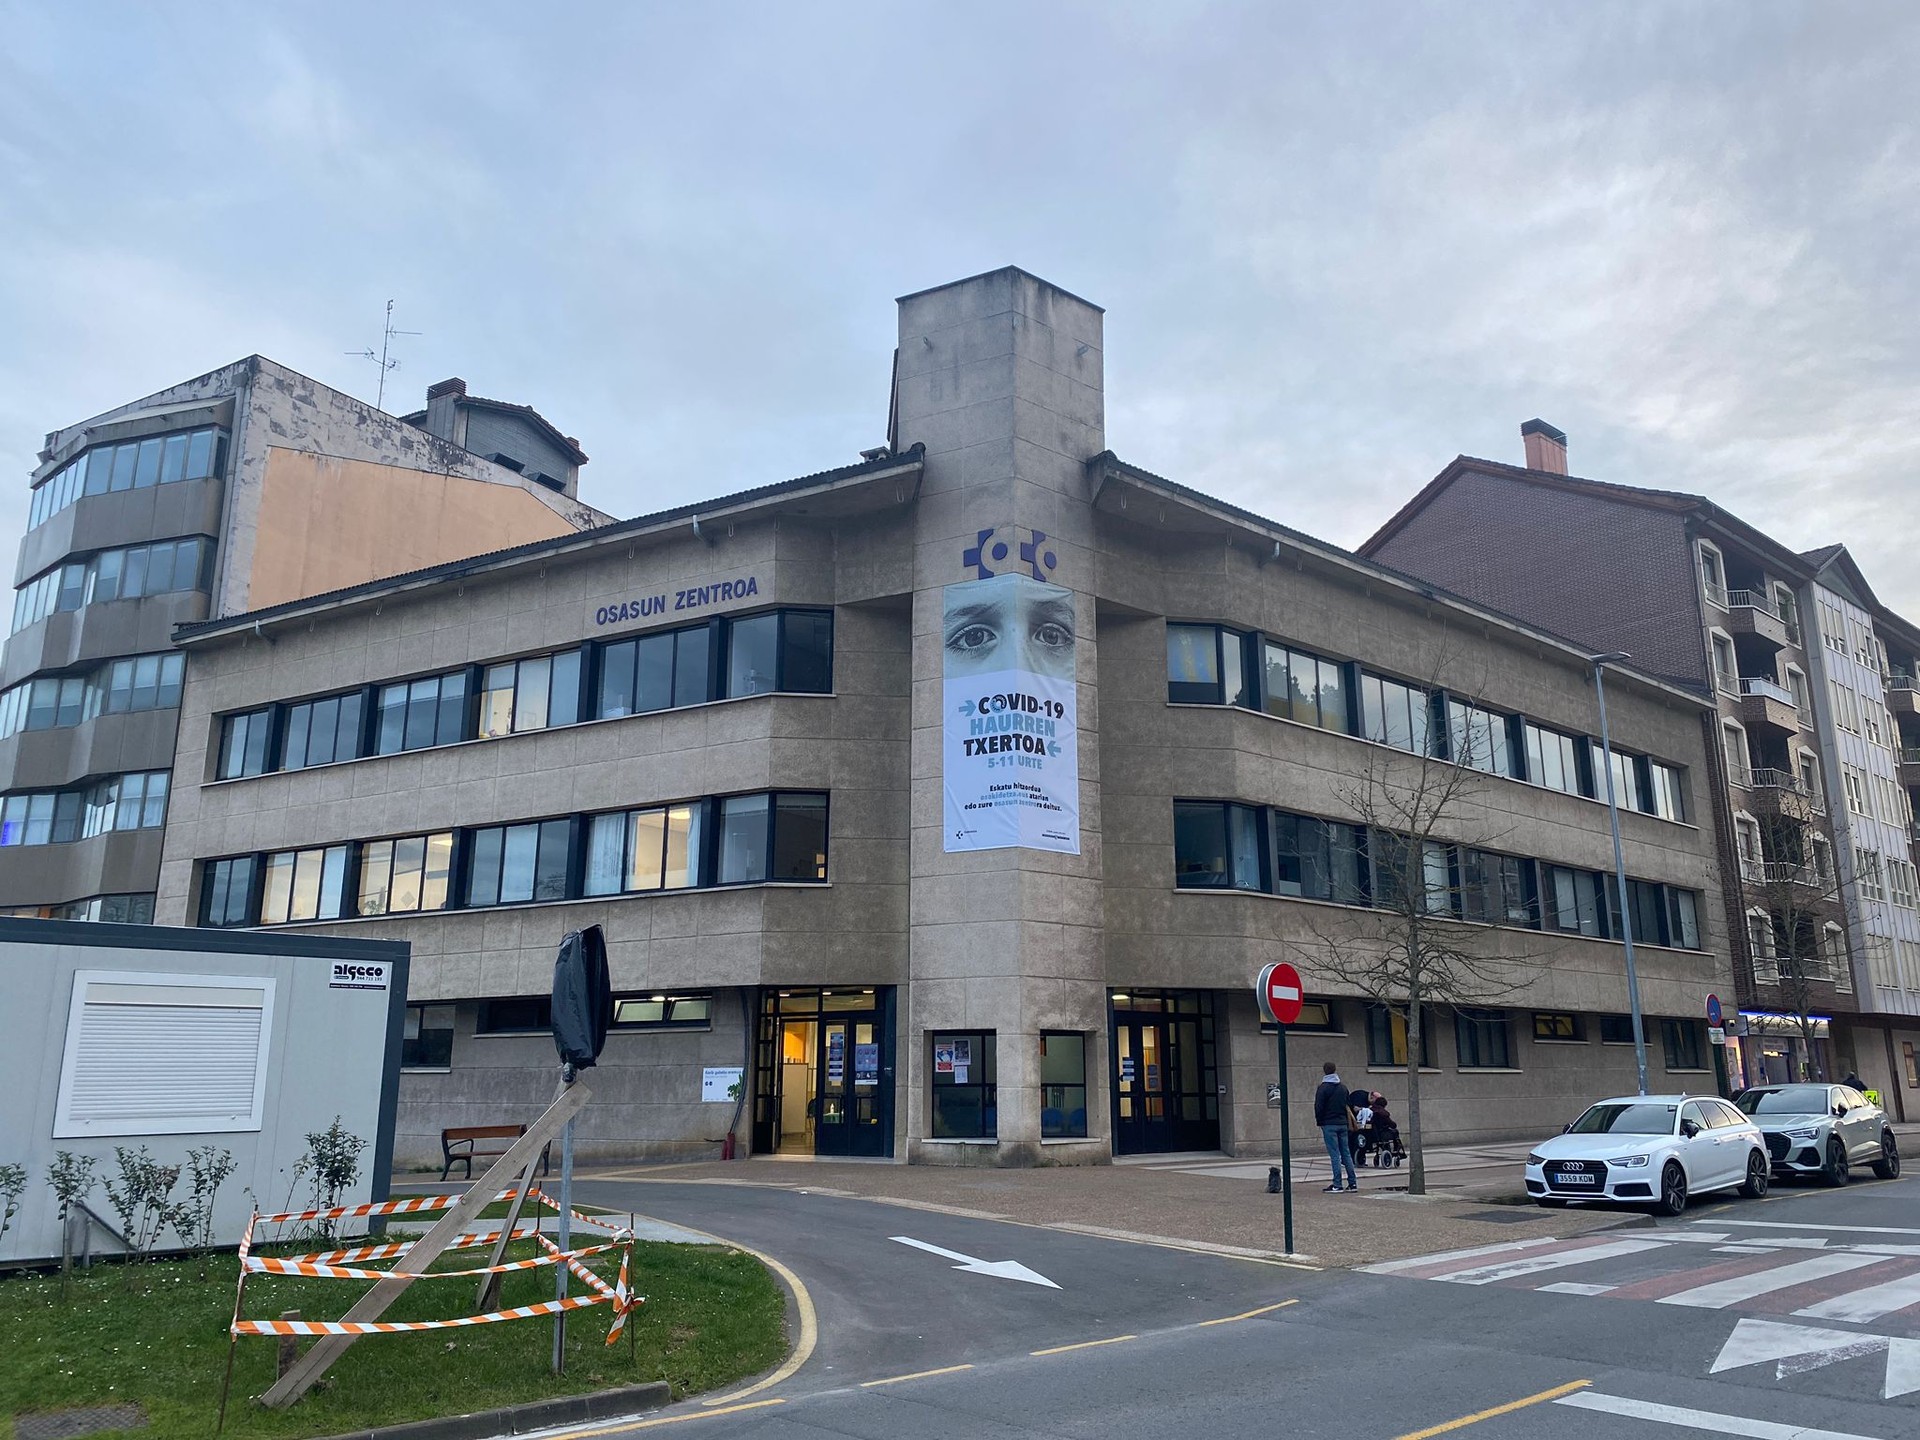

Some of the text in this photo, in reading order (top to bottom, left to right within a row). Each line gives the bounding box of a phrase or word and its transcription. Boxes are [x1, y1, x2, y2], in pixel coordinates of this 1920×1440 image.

[596, 577, 758, 625] OSASUN ZENTROA
[979, 693, 1064, 719] COVID-19
[970, 713, 1055, 737] HAURREN
[963, 733, 1046, 756] TXERTOA
[988, 756, 1042, 769] 5-11 URTE
[990, 782, 1041, 793] Eskatu hitzordua
[978, 801, 993, 809] zure
[1029, 793, 1049, 802] atarian
[333, 964, 383, 981] algeco
